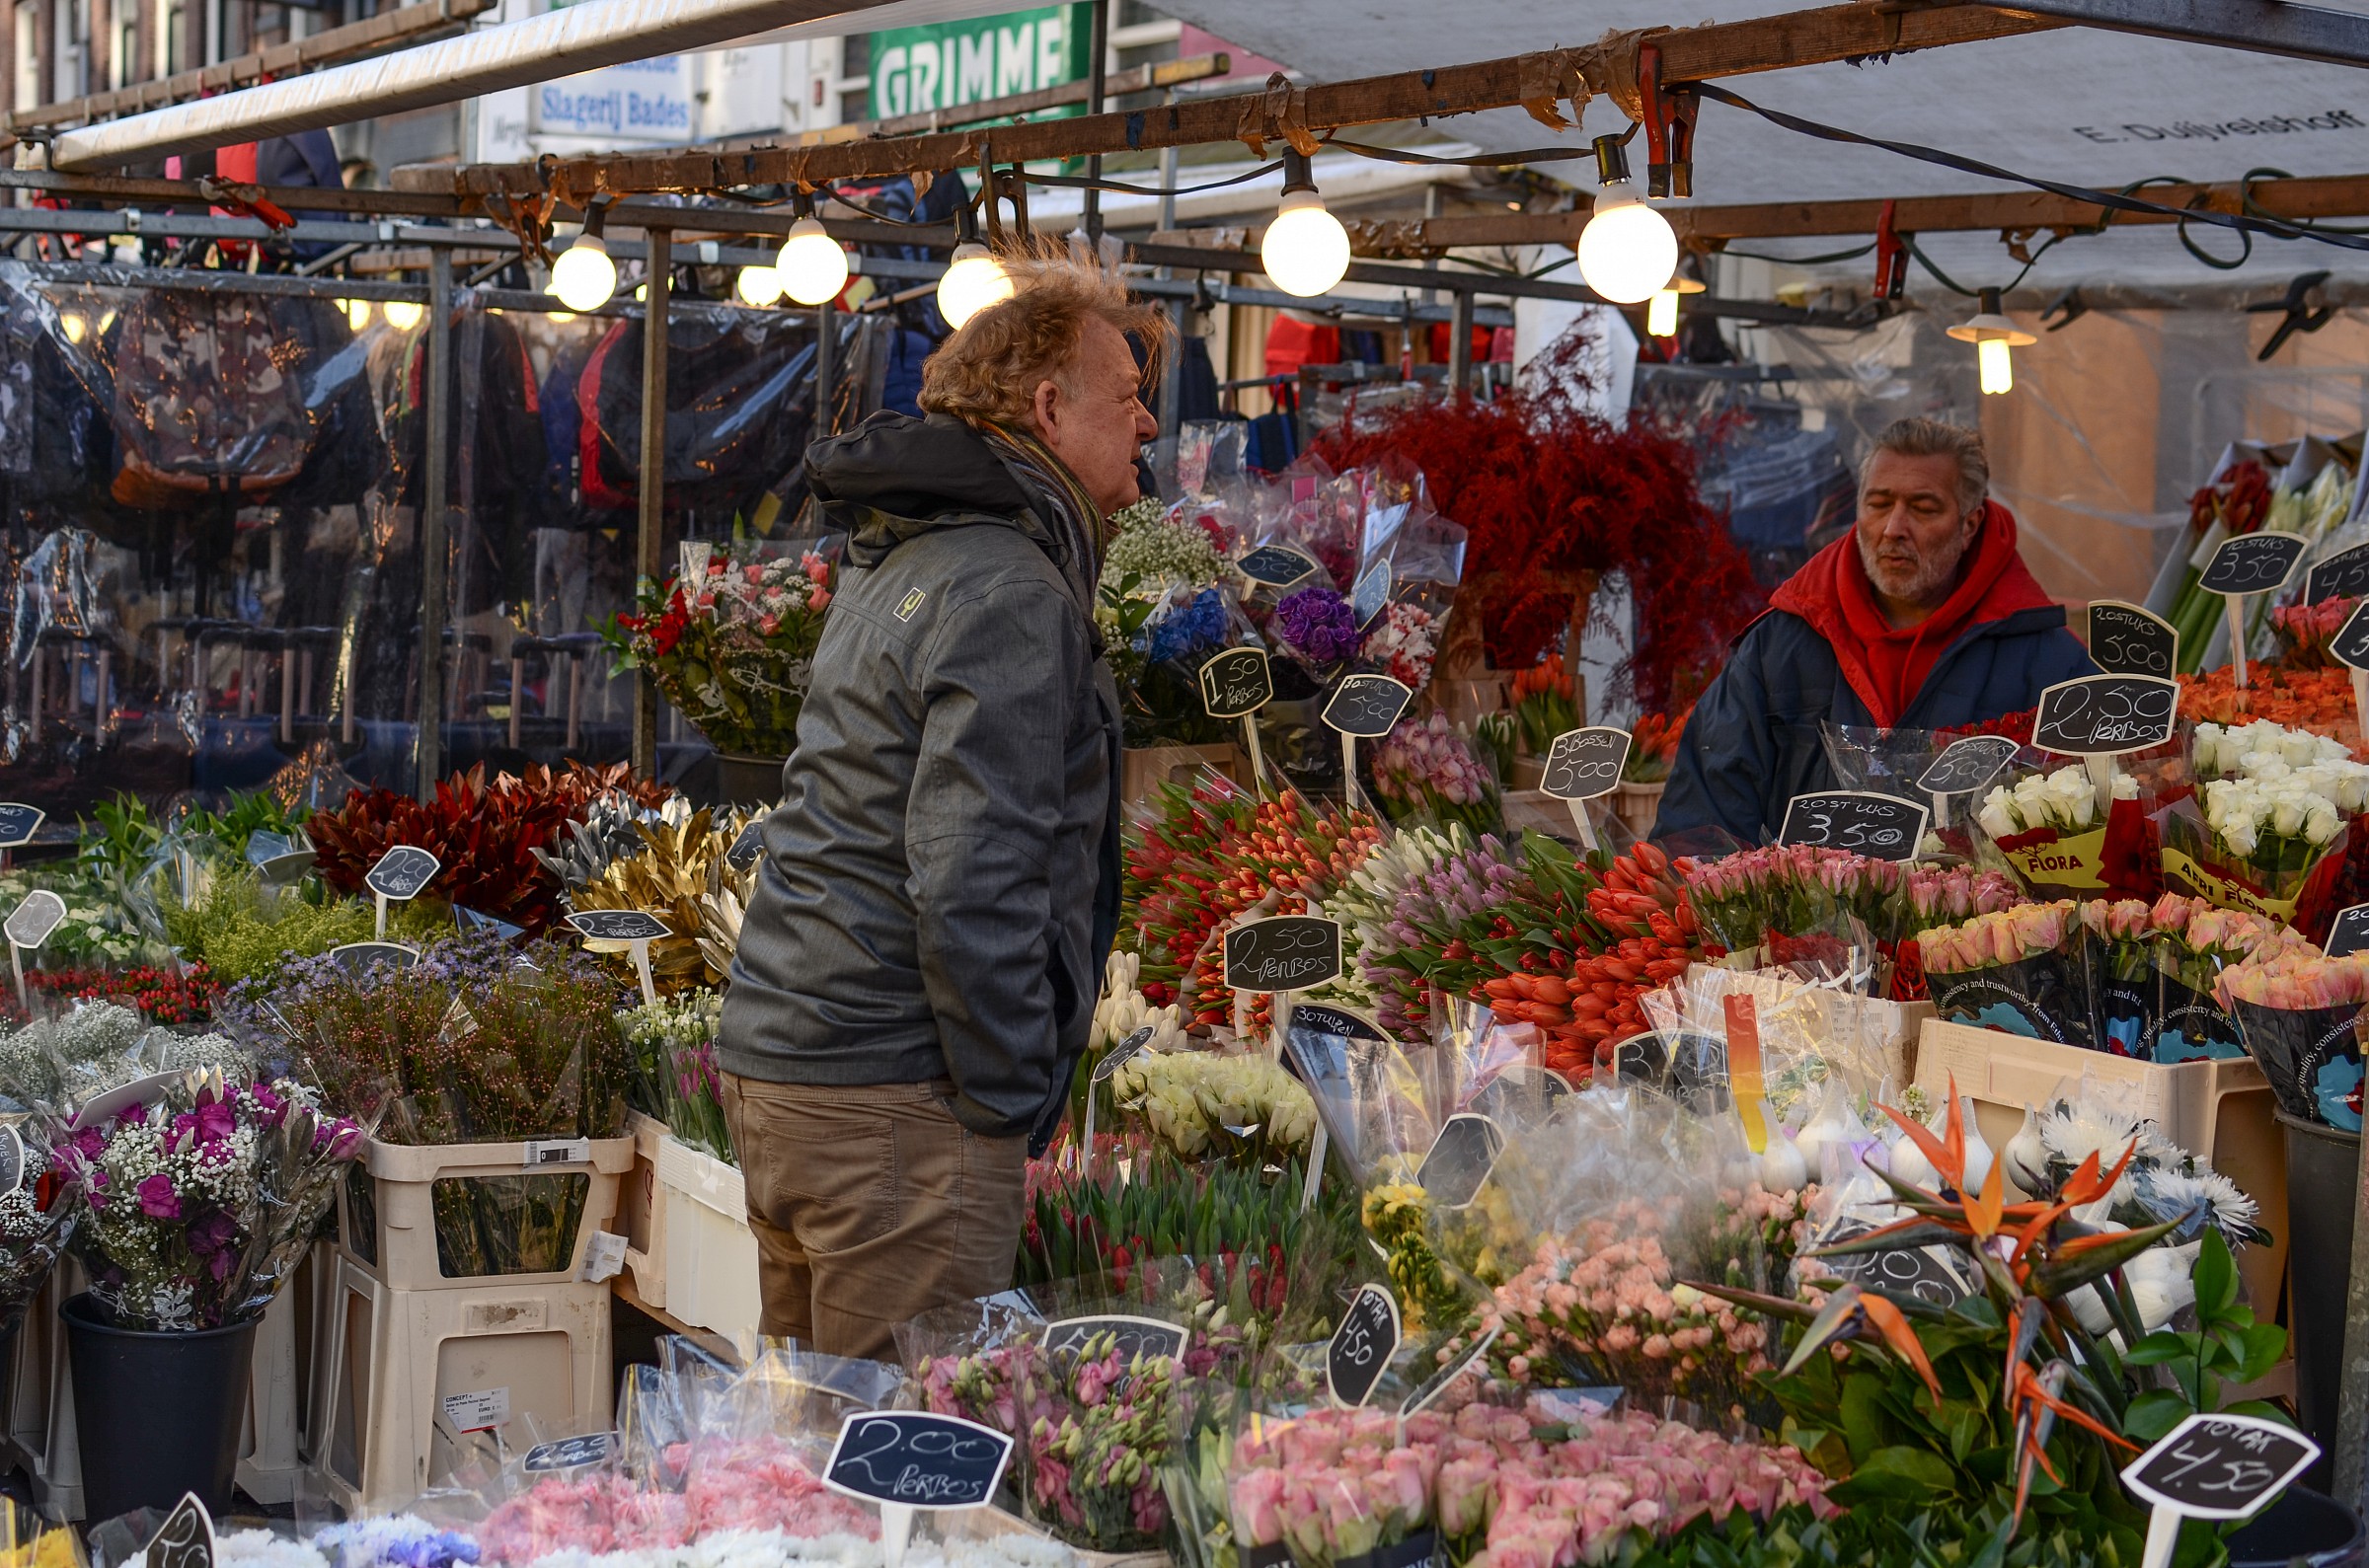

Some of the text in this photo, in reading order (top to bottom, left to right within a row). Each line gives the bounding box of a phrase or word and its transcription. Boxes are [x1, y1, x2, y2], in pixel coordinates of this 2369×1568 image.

[542, 86, 688, 130] Slagerij Bades
[2027, 855, 2085, 873] FLORA
[2180, 862, 2214, 897] AFRI
[1970, 978, 1985, 989] and
[446, 1393, 469, 1402] CONCEPT
